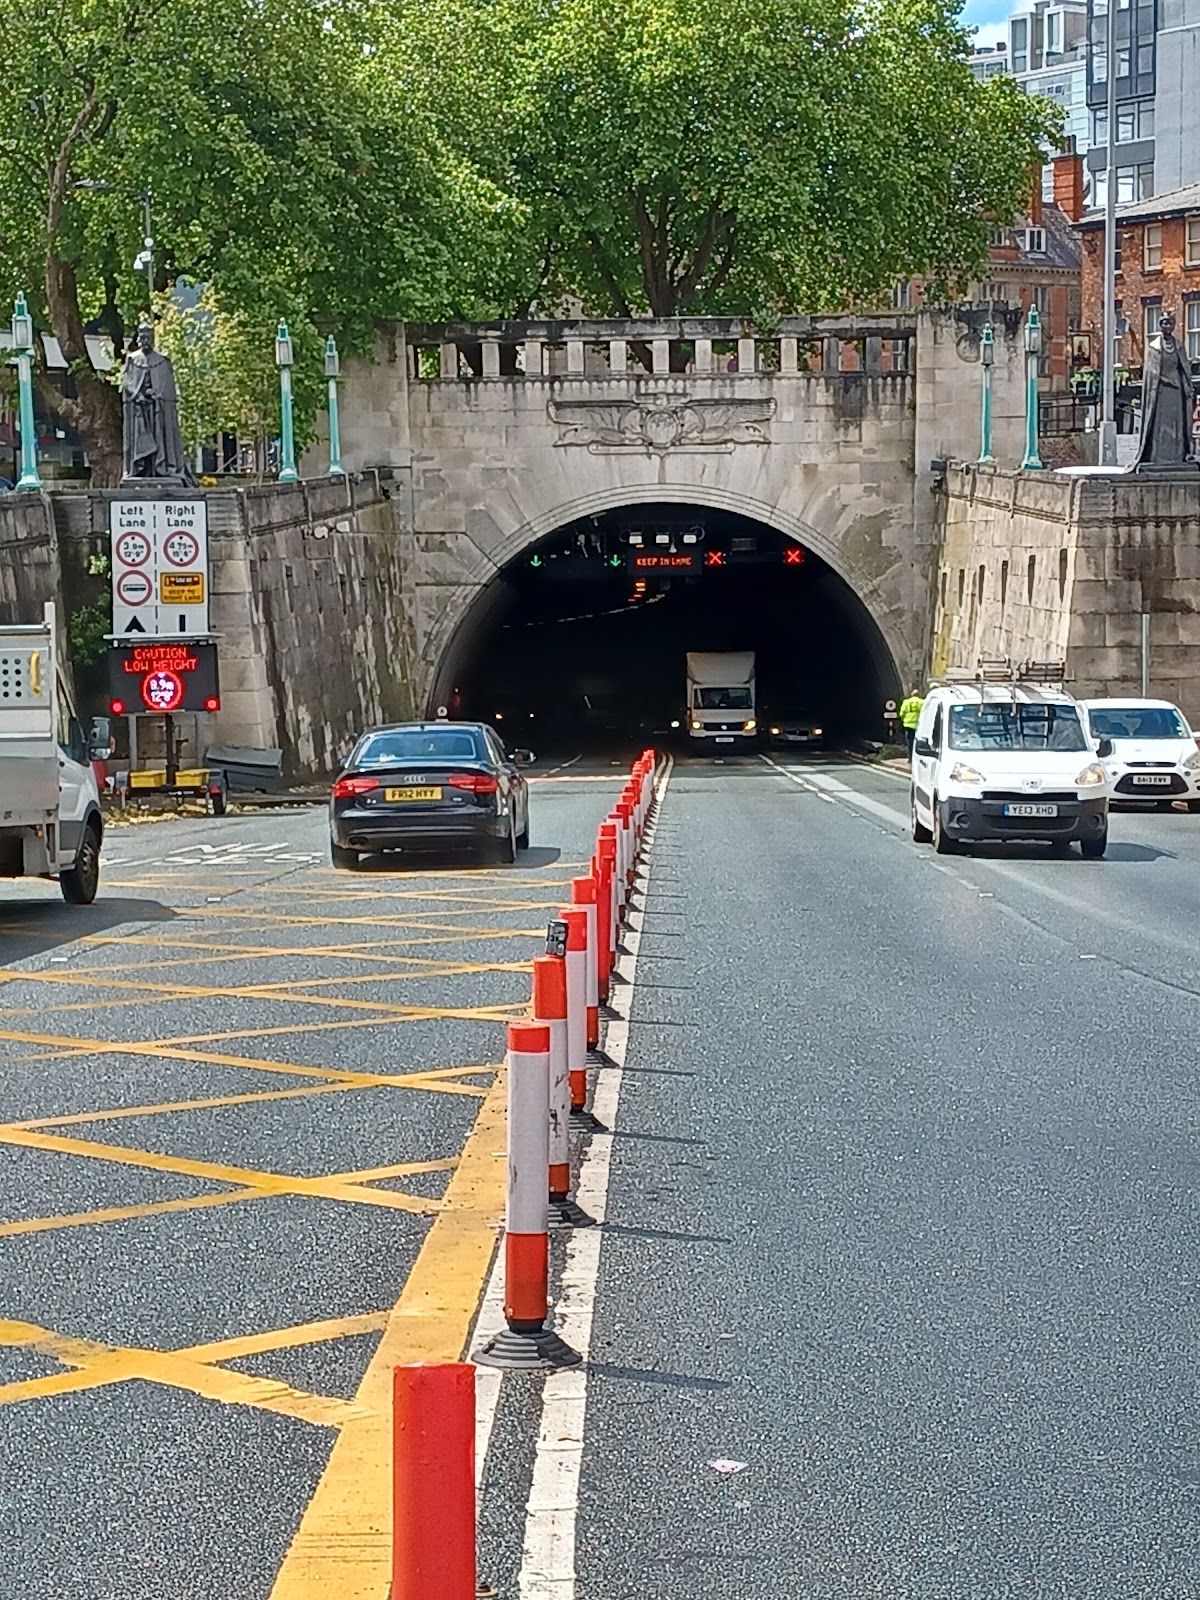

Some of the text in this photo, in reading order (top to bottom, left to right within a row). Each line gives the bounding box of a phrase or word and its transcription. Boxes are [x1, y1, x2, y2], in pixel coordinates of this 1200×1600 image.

[120, 506, 144, 516] Left
[165, 505, 196, 517] Right
[119, 518, 146, 528] Lane
[167, 517, 194, 528] Lane
[636, 557, 692, 566] KEEP IN LANE
[134, 647, 187, 660] CAUTION
[124, 658, 197, 672] LOW HEIGHT
[1035, 806, 1054, 815] XHD
